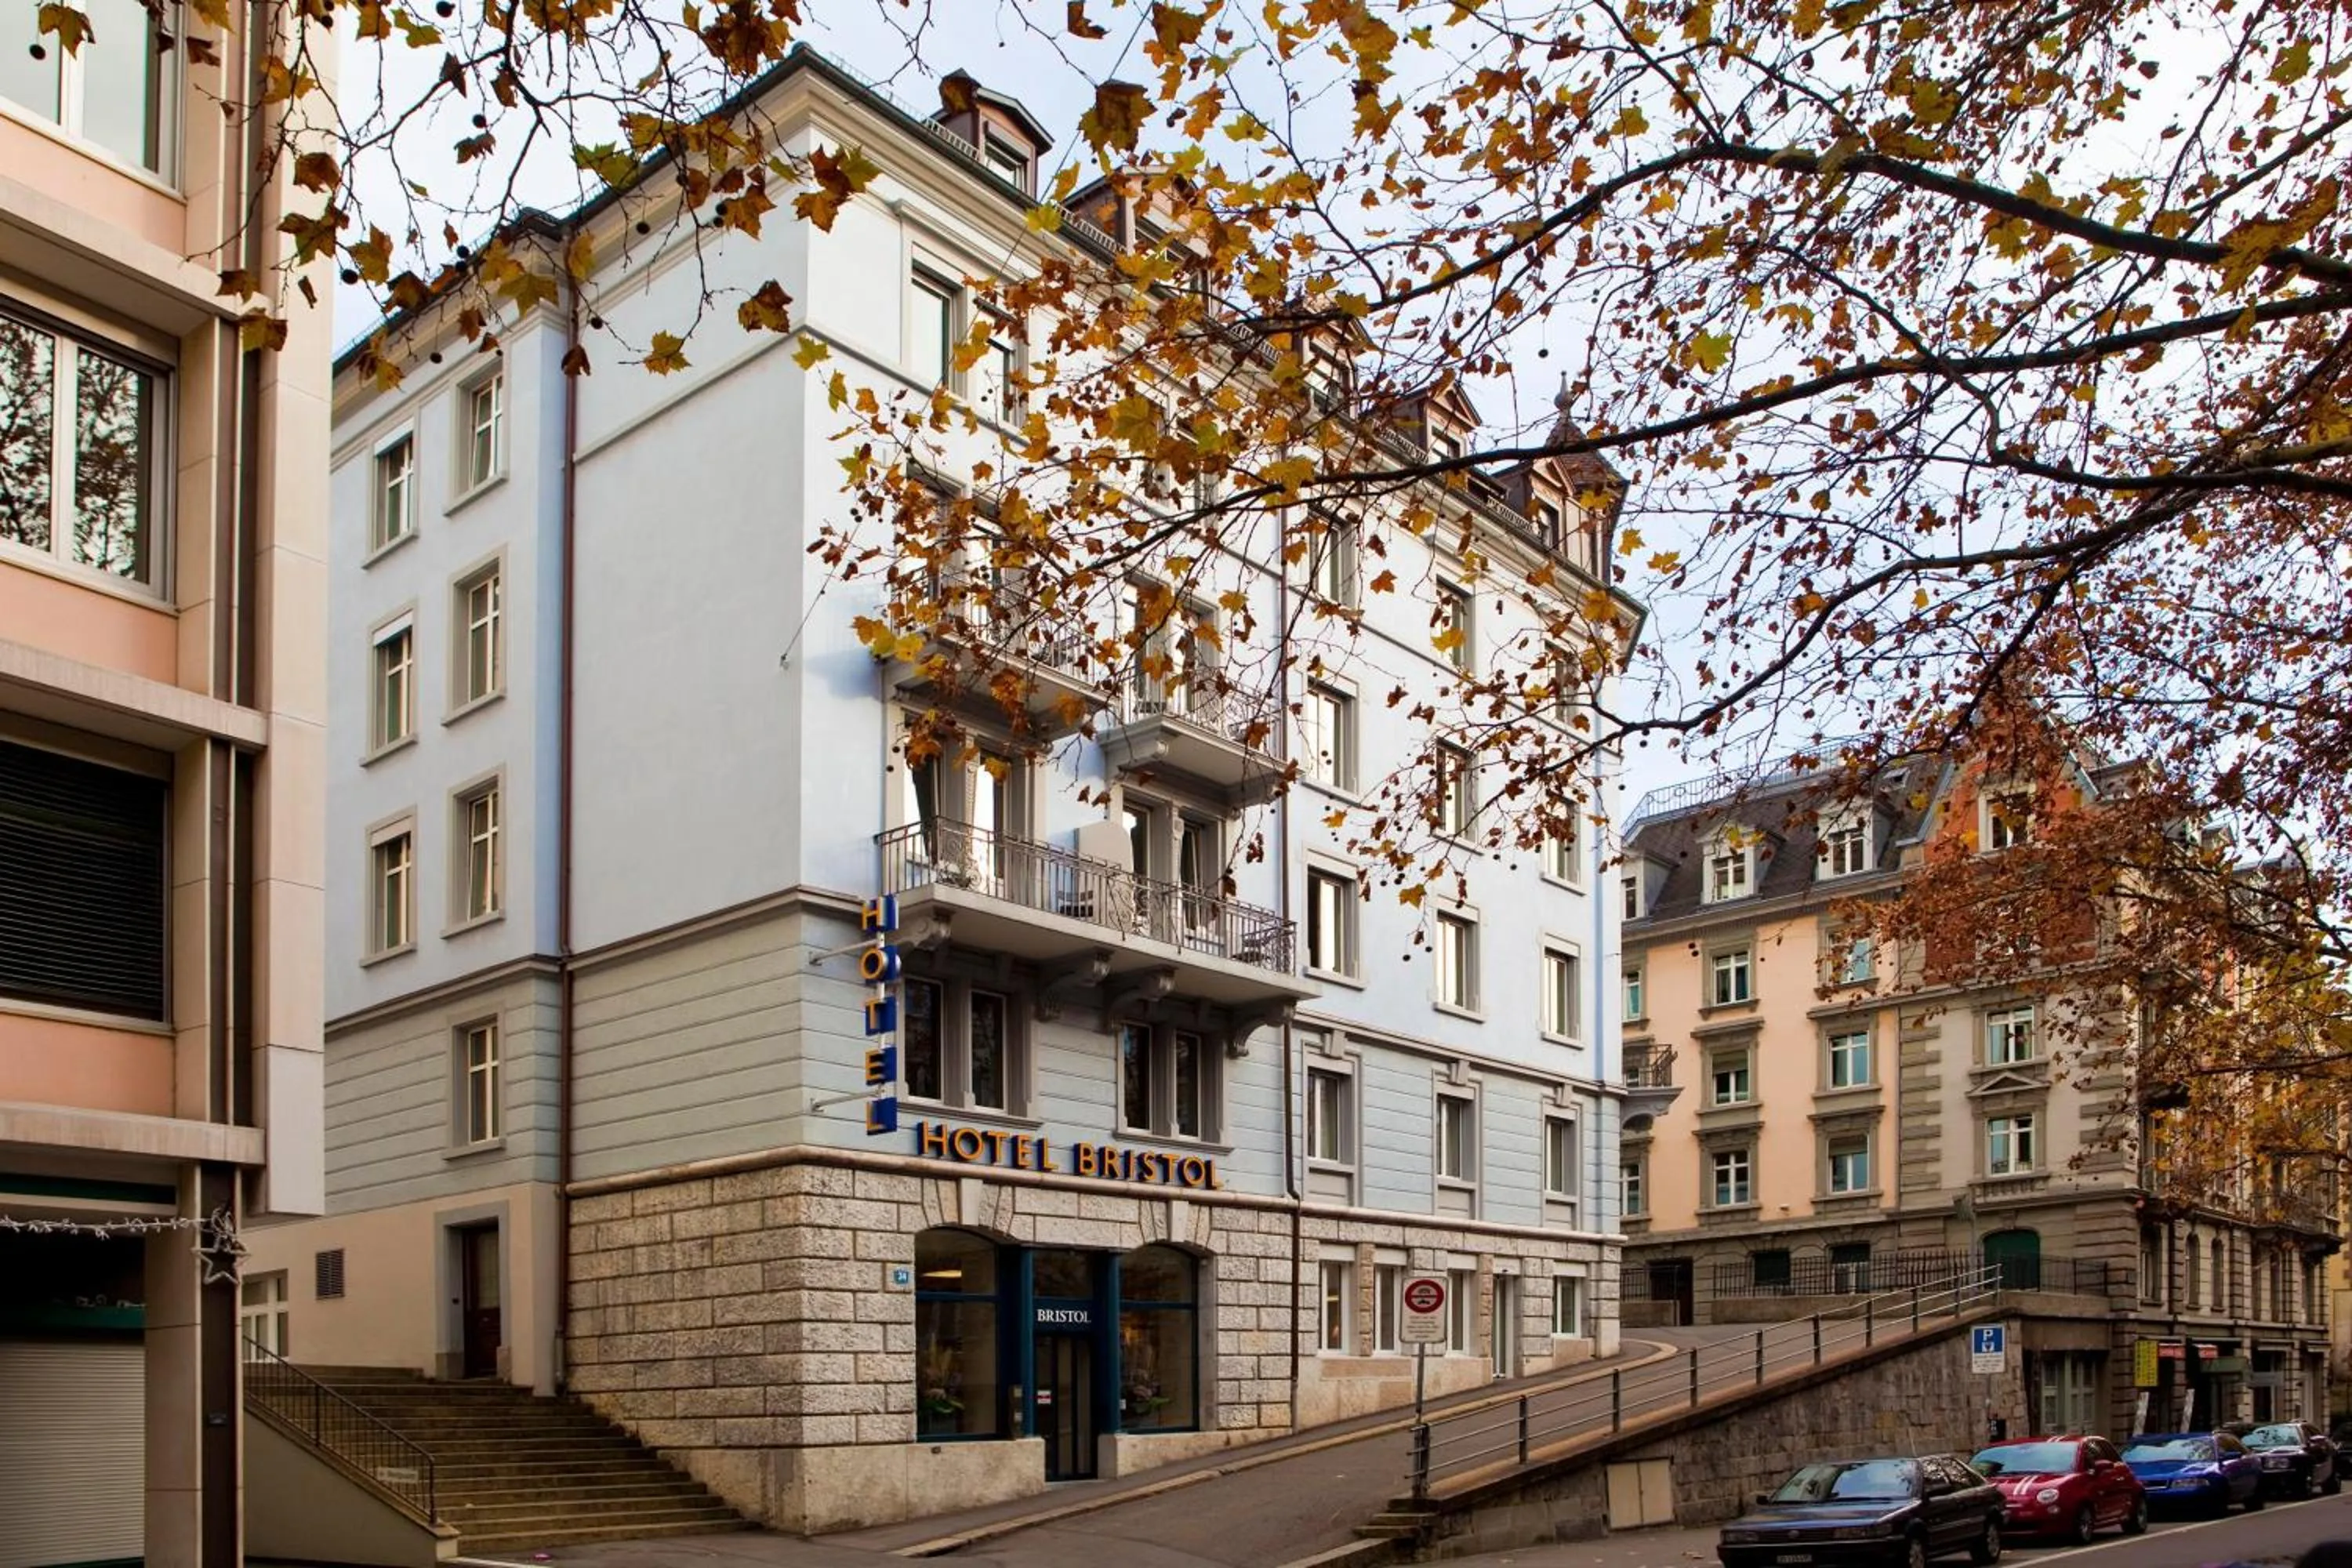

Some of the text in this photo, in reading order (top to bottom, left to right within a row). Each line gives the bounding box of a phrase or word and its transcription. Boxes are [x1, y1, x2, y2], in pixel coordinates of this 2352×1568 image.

[861, 895, 897, 1134] HOTEL
[917, 1117, 1223, 1189] HOTEL BRISTOL
[1036, 1308, 1091, 1323] BRISTOL
[1983, 1329, 1994, 1341] P
